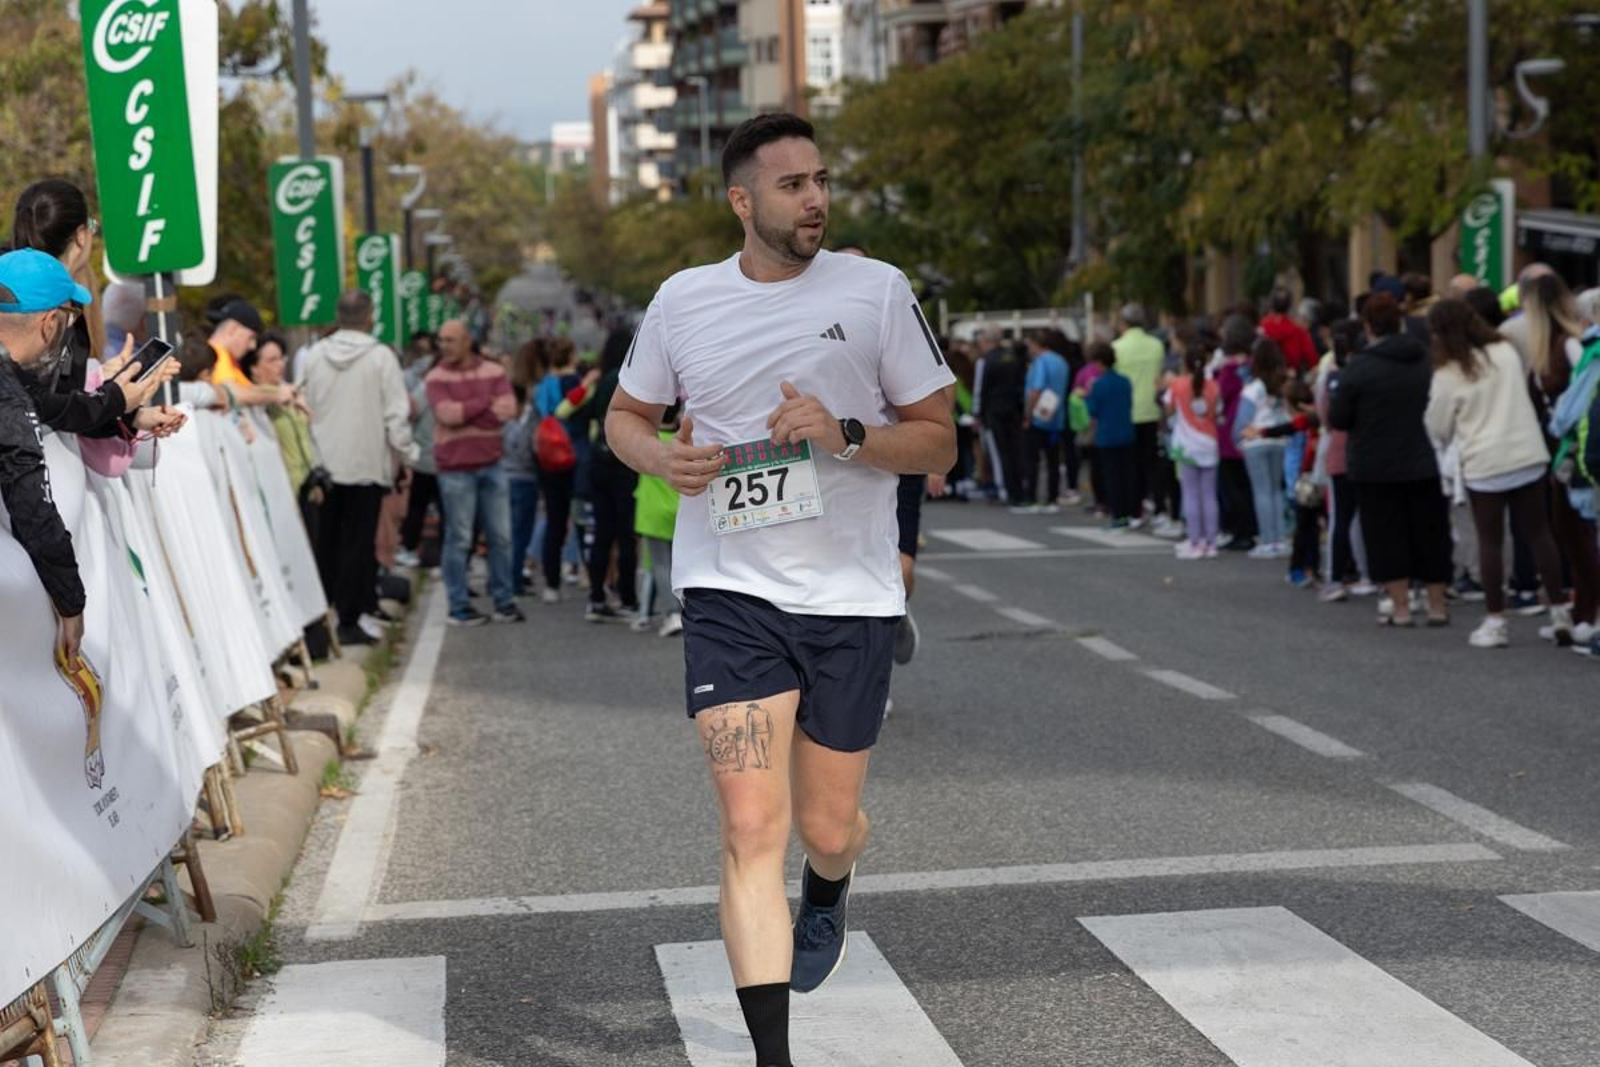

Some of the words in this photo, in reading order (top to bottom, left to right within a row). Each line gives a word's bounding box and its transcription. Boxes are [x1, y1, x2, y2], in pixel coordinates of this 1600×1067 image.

[107, 11, 170, 45] CSIF
[125, 79, 166, 263] CSIF
[295, 215, 321, 320] CSIF
[725, 466, 789, 511] 257
